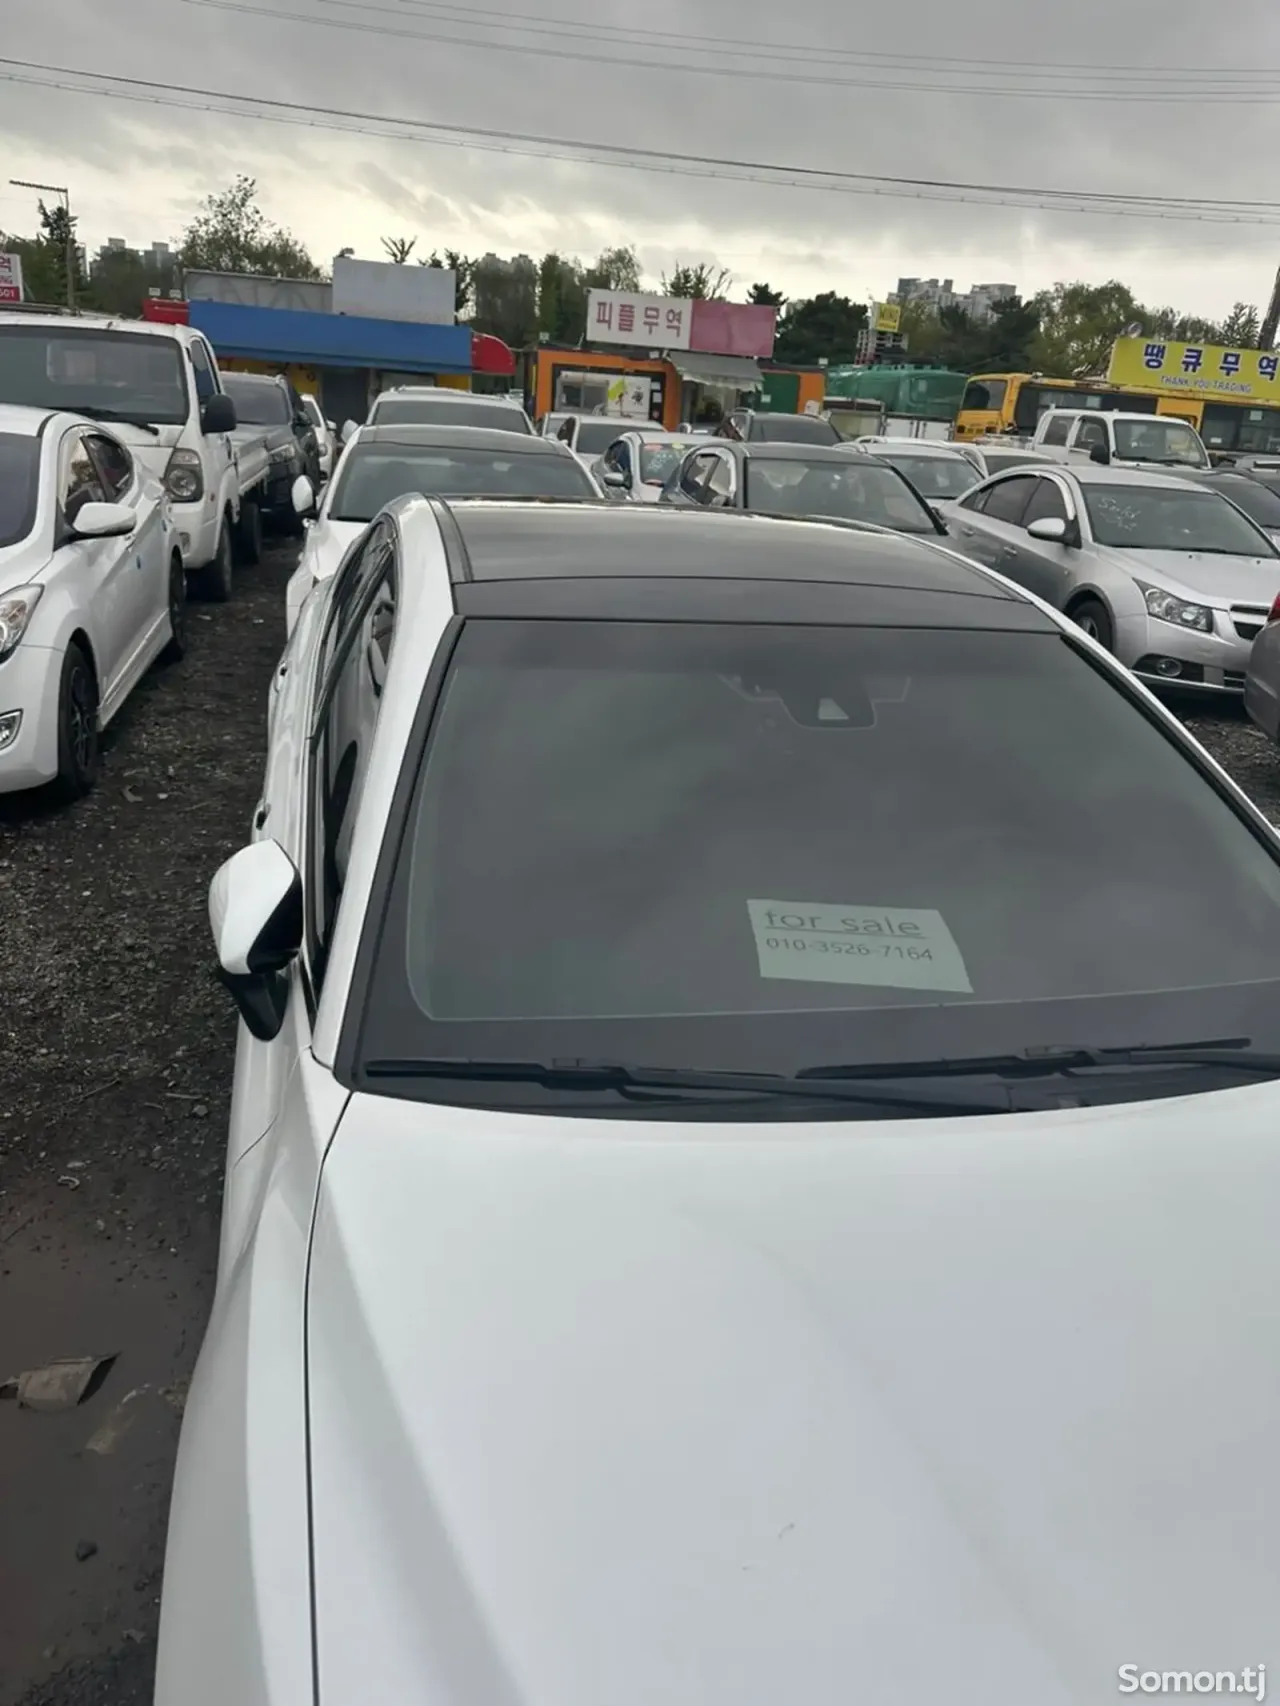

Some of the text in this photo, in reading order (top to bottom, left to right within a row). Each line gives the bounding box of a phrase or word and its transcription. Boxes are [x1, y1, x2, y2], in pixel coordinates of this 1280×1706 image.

[1160, 376, 1252, 393] THANK YOU TRADING
[765, 911, 922, 936] for sale
[766, 937, 932, 961] 010-3526-7164
